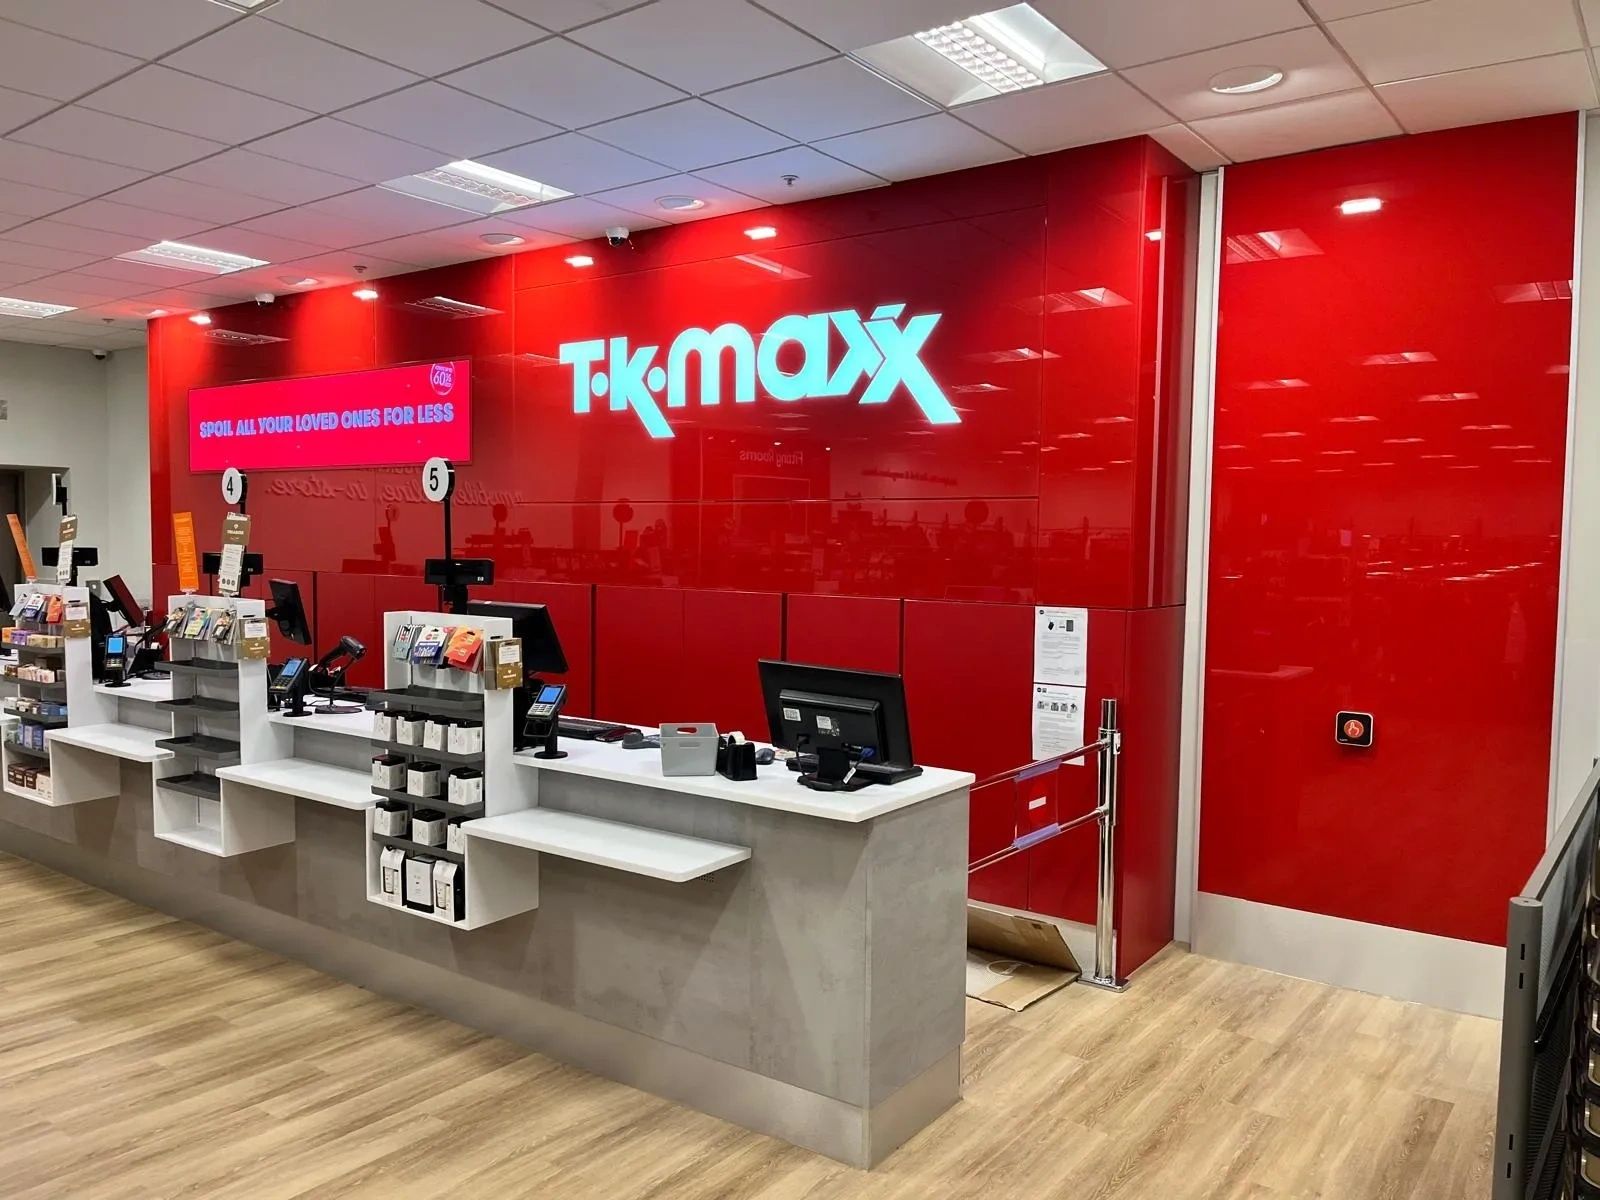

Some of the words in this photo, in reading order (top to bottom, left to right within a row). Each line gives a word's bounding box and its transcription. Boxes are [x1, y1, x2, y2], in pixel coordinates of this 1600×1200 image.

[199, 420, 234, 438] SPOIL
[236, 418, 257, 436] ALL
[258, 415, 294, 435] YOUR
[295, 411, 339, 432] LOVED
[341, 408, 381, 429] ONES
[383, 405, 415, 426] FOR
[417, 402, 454, 424] LESS
[226, 476, 234, 496] 4
[429, 467, 439, 491] 5
